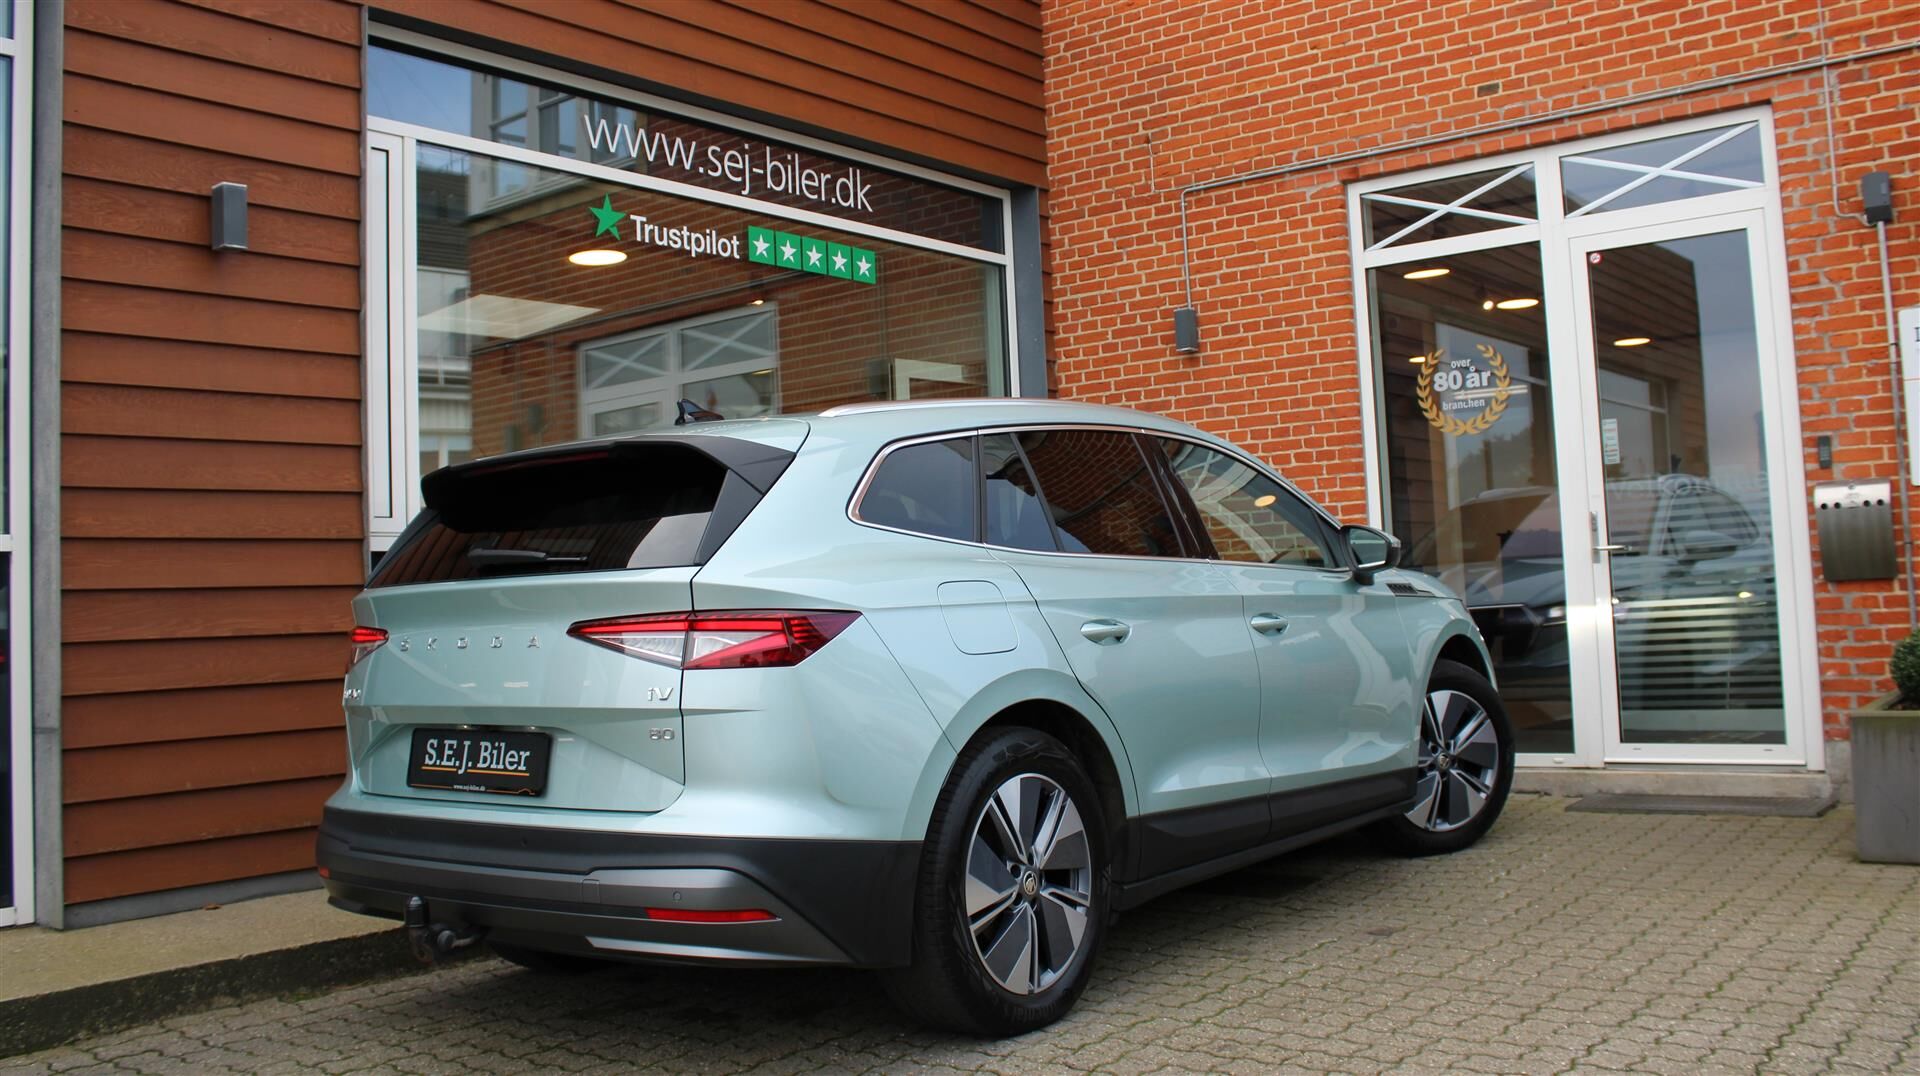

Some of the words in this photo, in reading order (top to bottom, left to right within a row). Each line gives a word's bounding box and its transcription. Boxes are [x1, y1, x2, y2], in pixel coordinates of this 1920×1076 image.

[584, 114, 873, 212] www.sej-biler.dk
[630, 214, 740, 259] Trustpilot
[1450, 359, 1471, 369] over
[1433, 370, 1462, 392] 80
[1465, 366, 1491, 388] år
[1442, 399, 1485, 410] branchen
[649, 727, 675, 741] 80
[424, 738, 472, 774] S.E.J.
[477, 741, 531, 771] Biler
